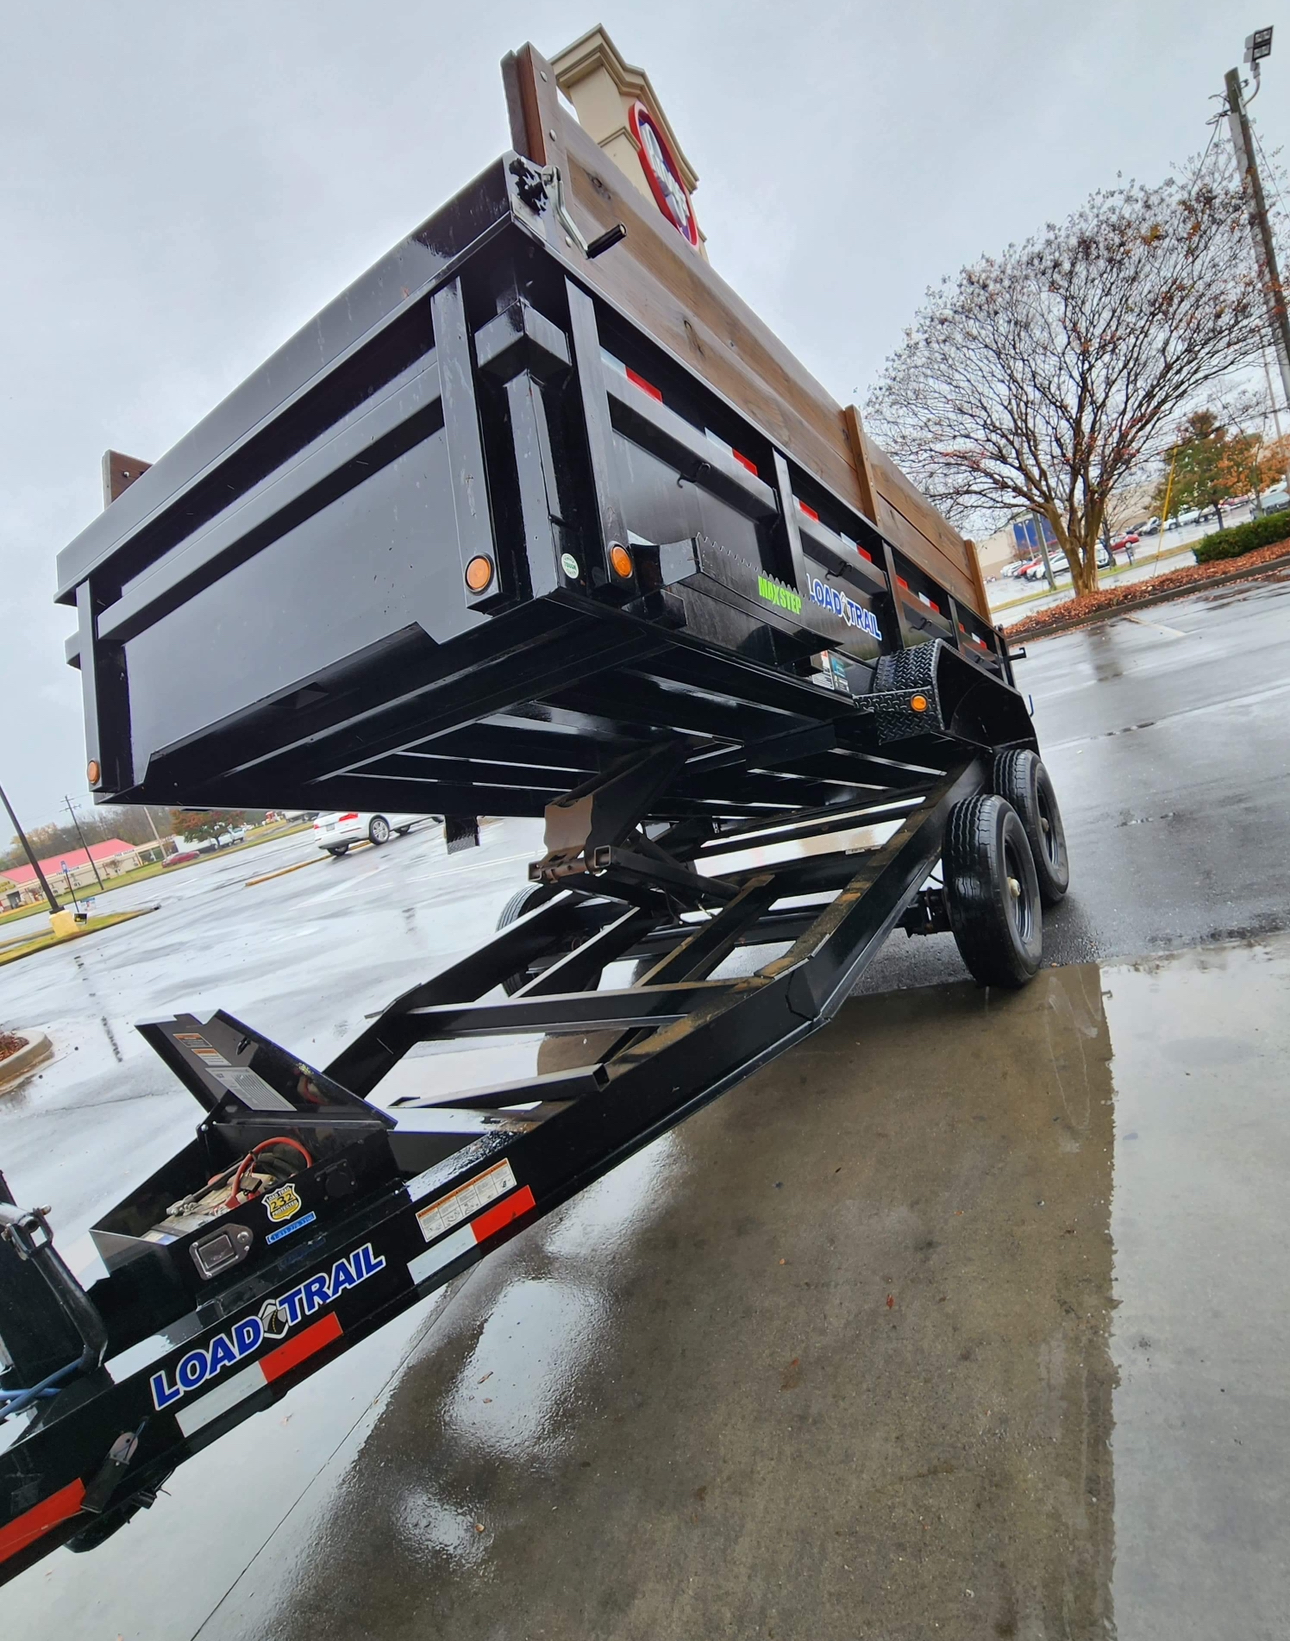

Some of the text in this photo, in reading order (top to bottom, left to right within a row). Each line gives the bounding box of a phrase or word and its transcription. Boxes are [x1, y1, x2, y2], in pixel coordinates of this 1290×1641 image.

[758, 575, 802, 615] MAXSTEP
[806, 573, 883, 641] LOAD TRAIL
[266, 1193, 278, 1202] LOAD
[271, 1193, 293, 1210] 232
[271, 1199, 298, 1216] PROTECTED
[150, 1243, 386, 1410] LOAD TRAIL
